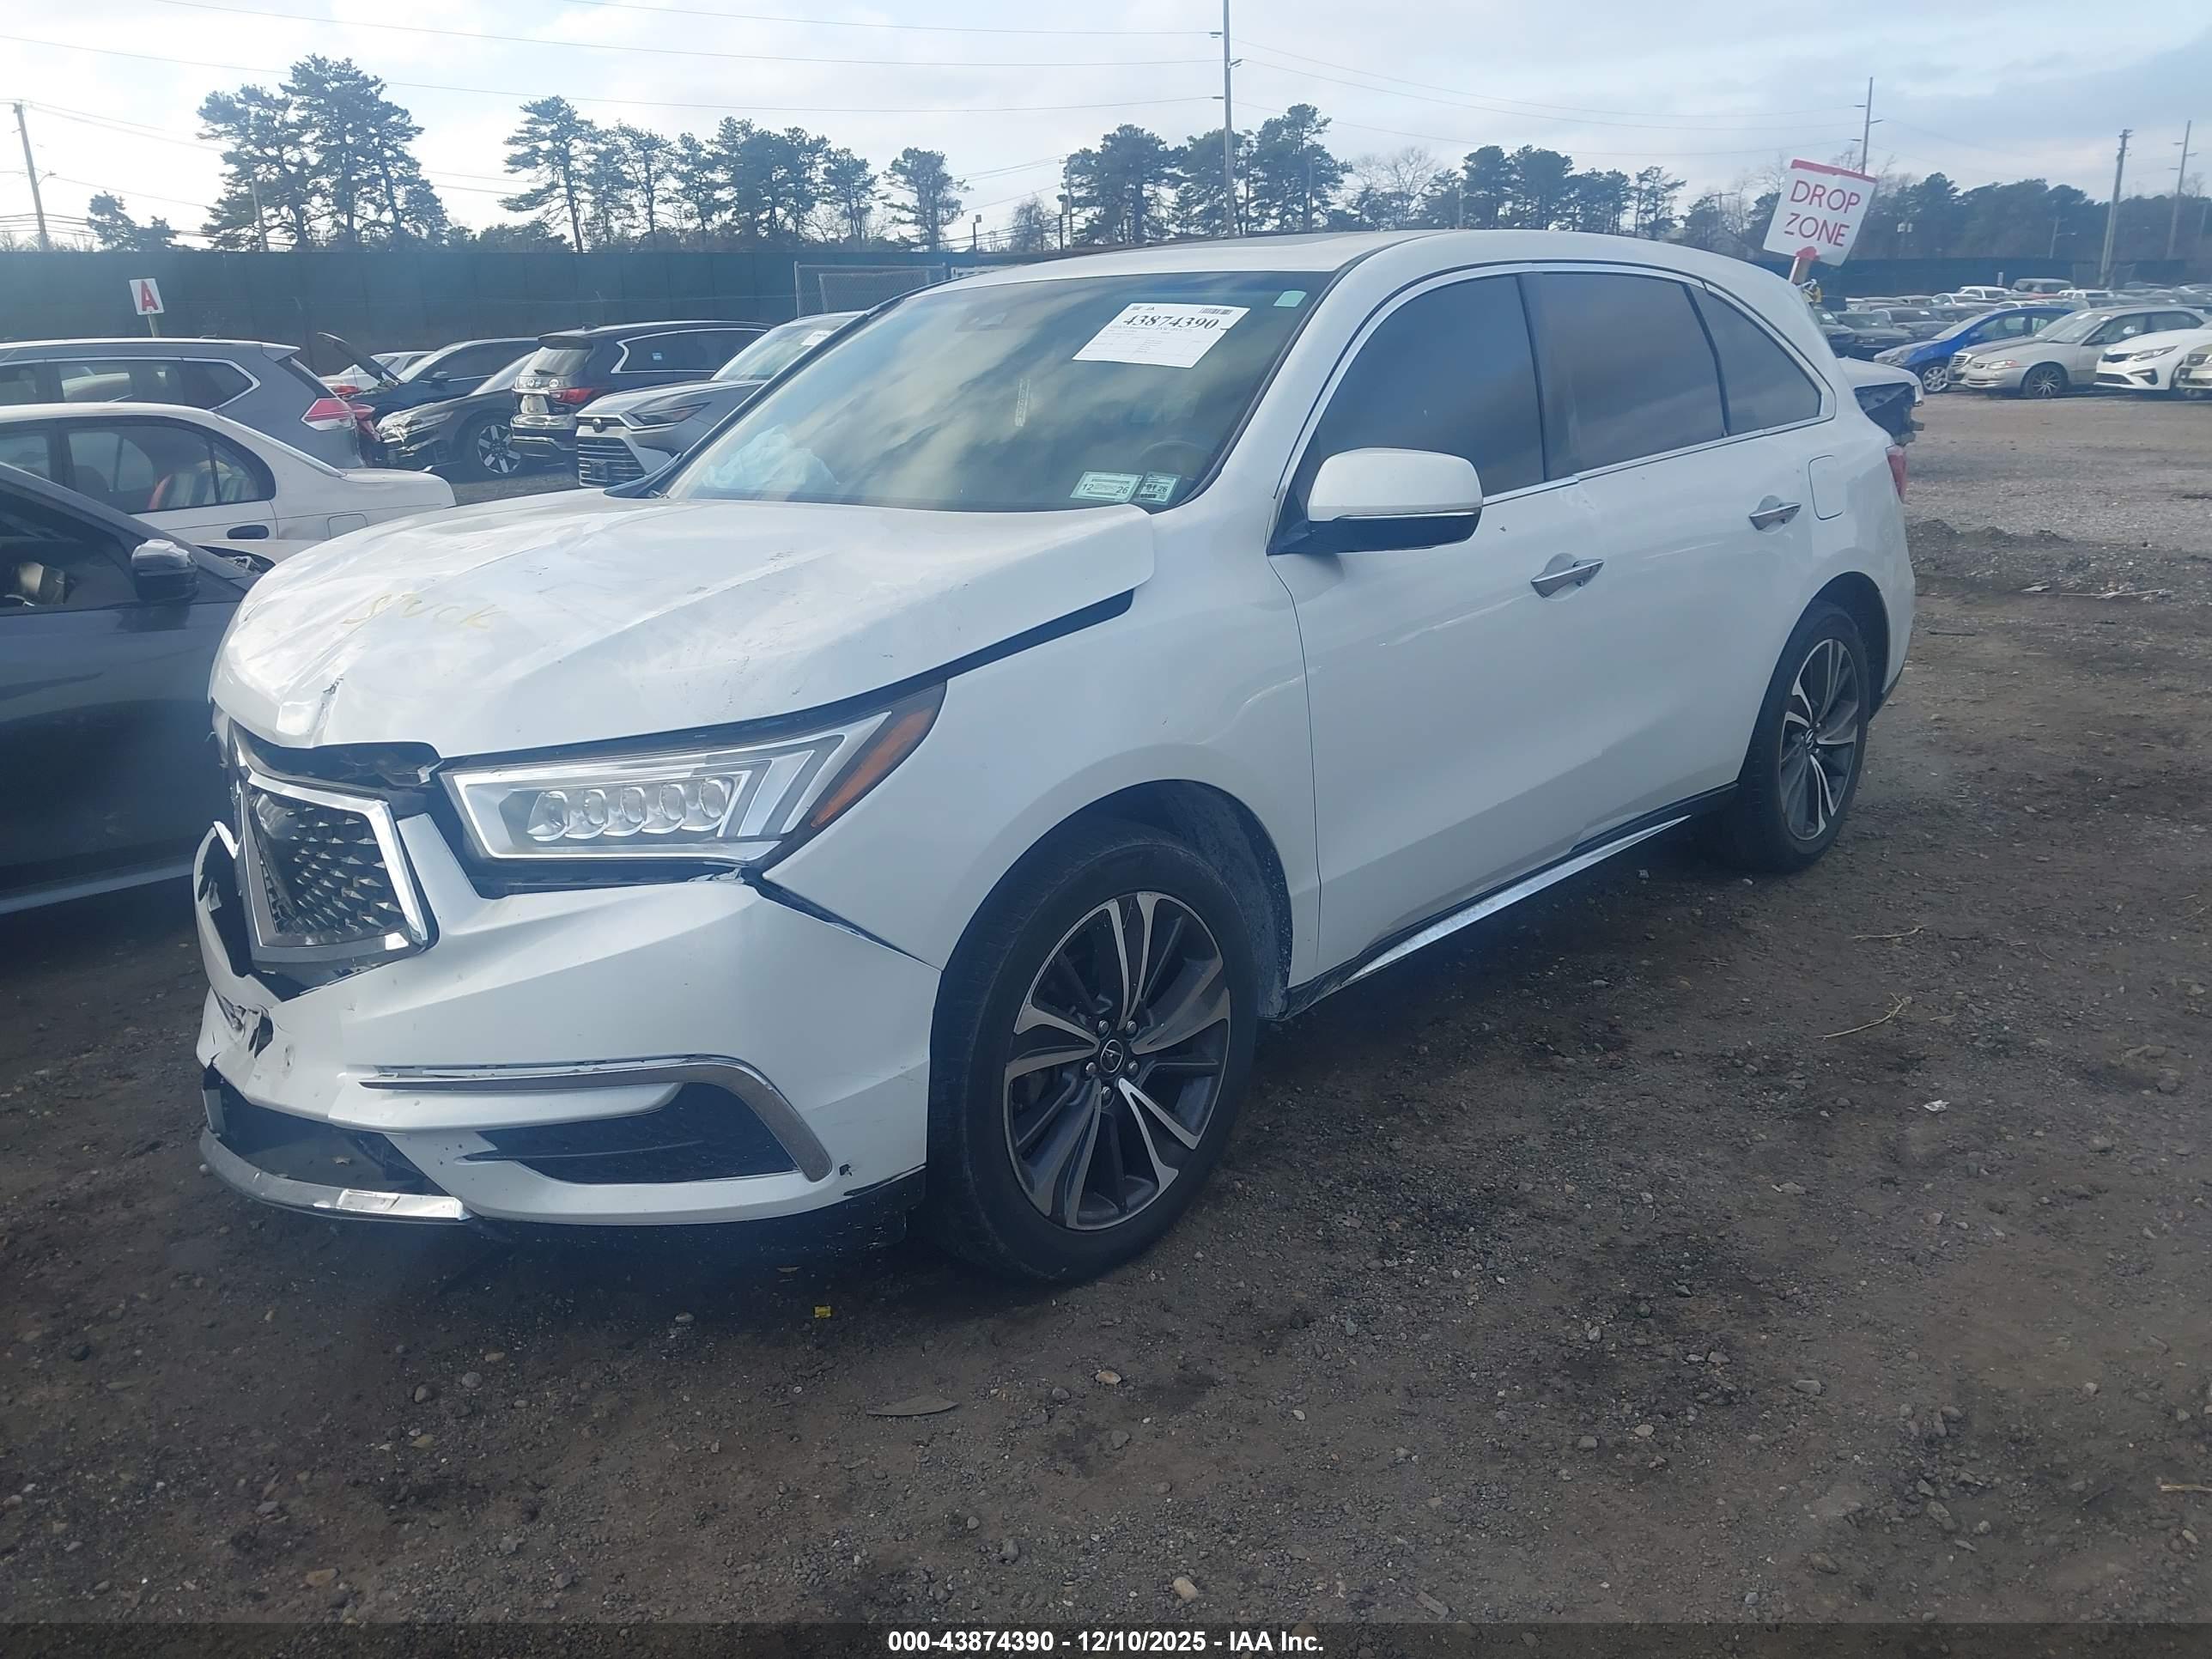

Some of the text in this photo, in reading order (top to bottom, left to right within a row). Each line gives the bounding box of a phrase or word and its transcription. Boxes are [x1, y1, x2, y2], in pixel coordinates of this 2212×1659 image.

[1790, 179, 1861, 213] DROP
[1784, 212, 1850, 246] ZONE
[141, 280, 159, 312] A
[1123, 314, 1220, 330] 43874390
[1115, 486, 1130, 495] 26
